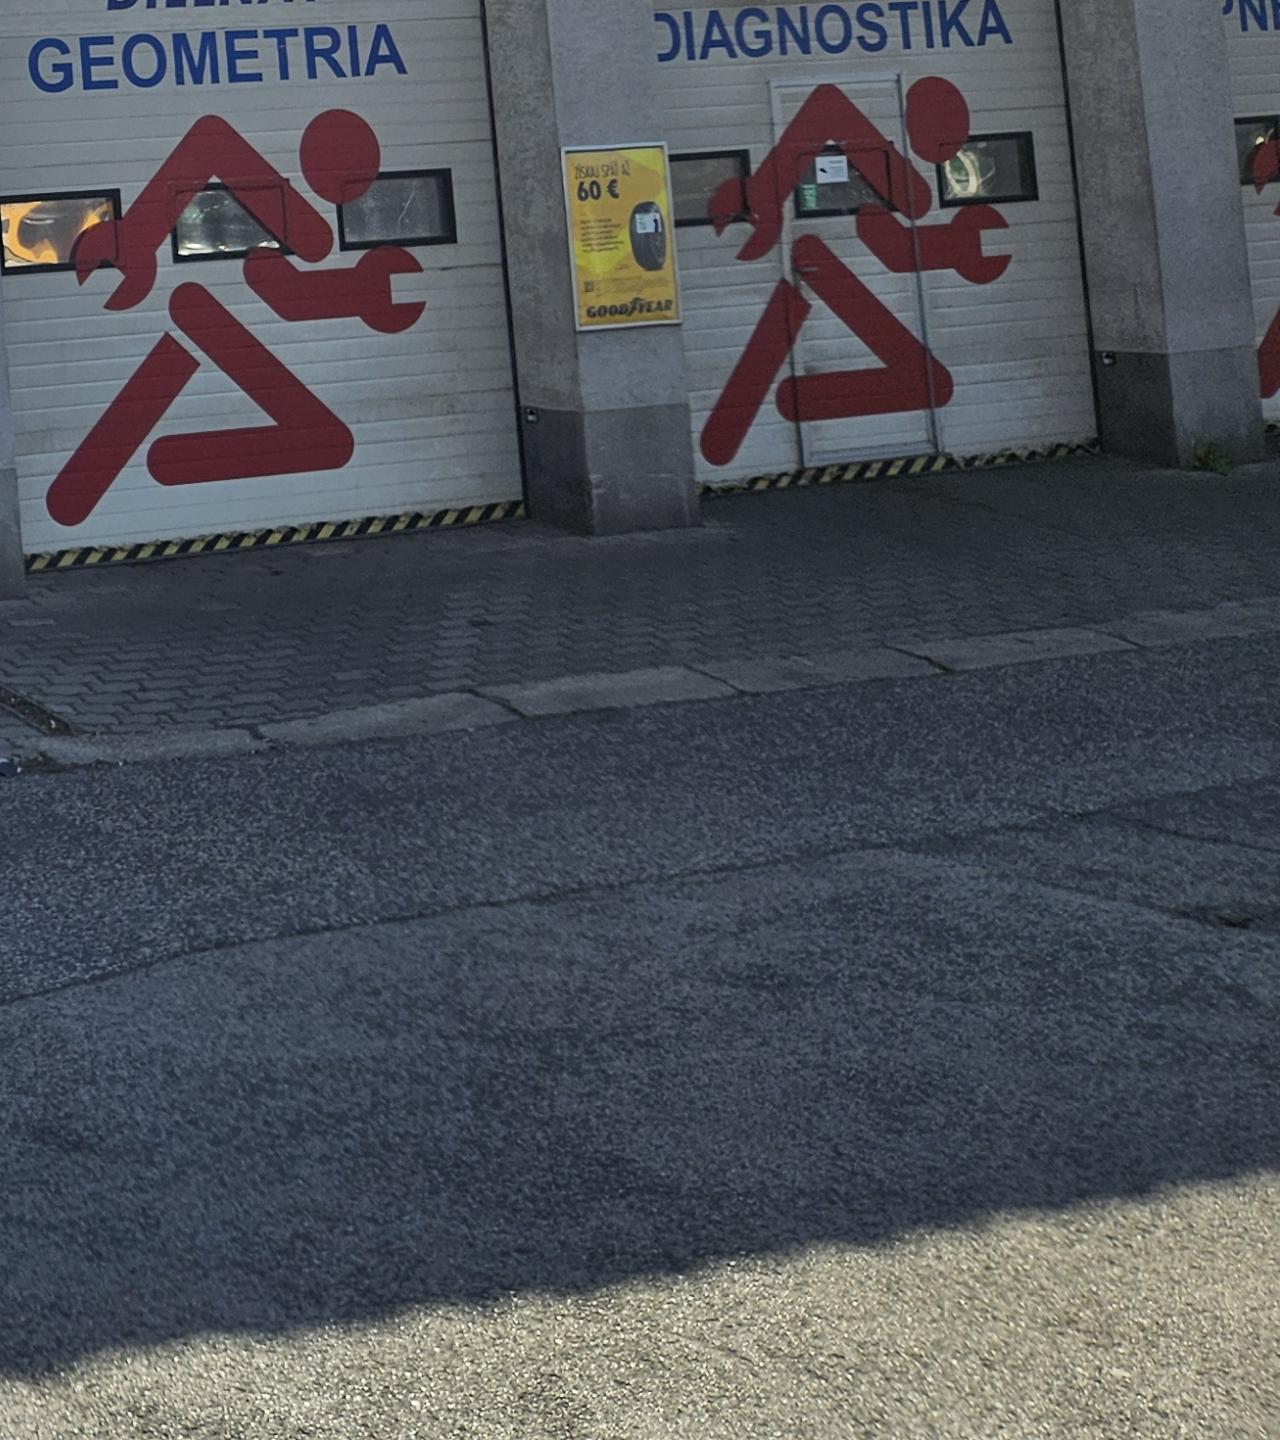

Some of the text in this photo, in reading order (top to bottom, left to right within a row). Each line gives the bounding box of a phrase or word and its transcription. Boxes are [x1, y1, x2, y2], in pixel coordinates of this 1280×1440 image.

[27, 23, 408, 94] GEOMETRIA
[576, 178, 620, 202] 60 €
[585, 297, 674, 319] GOODYEAR
